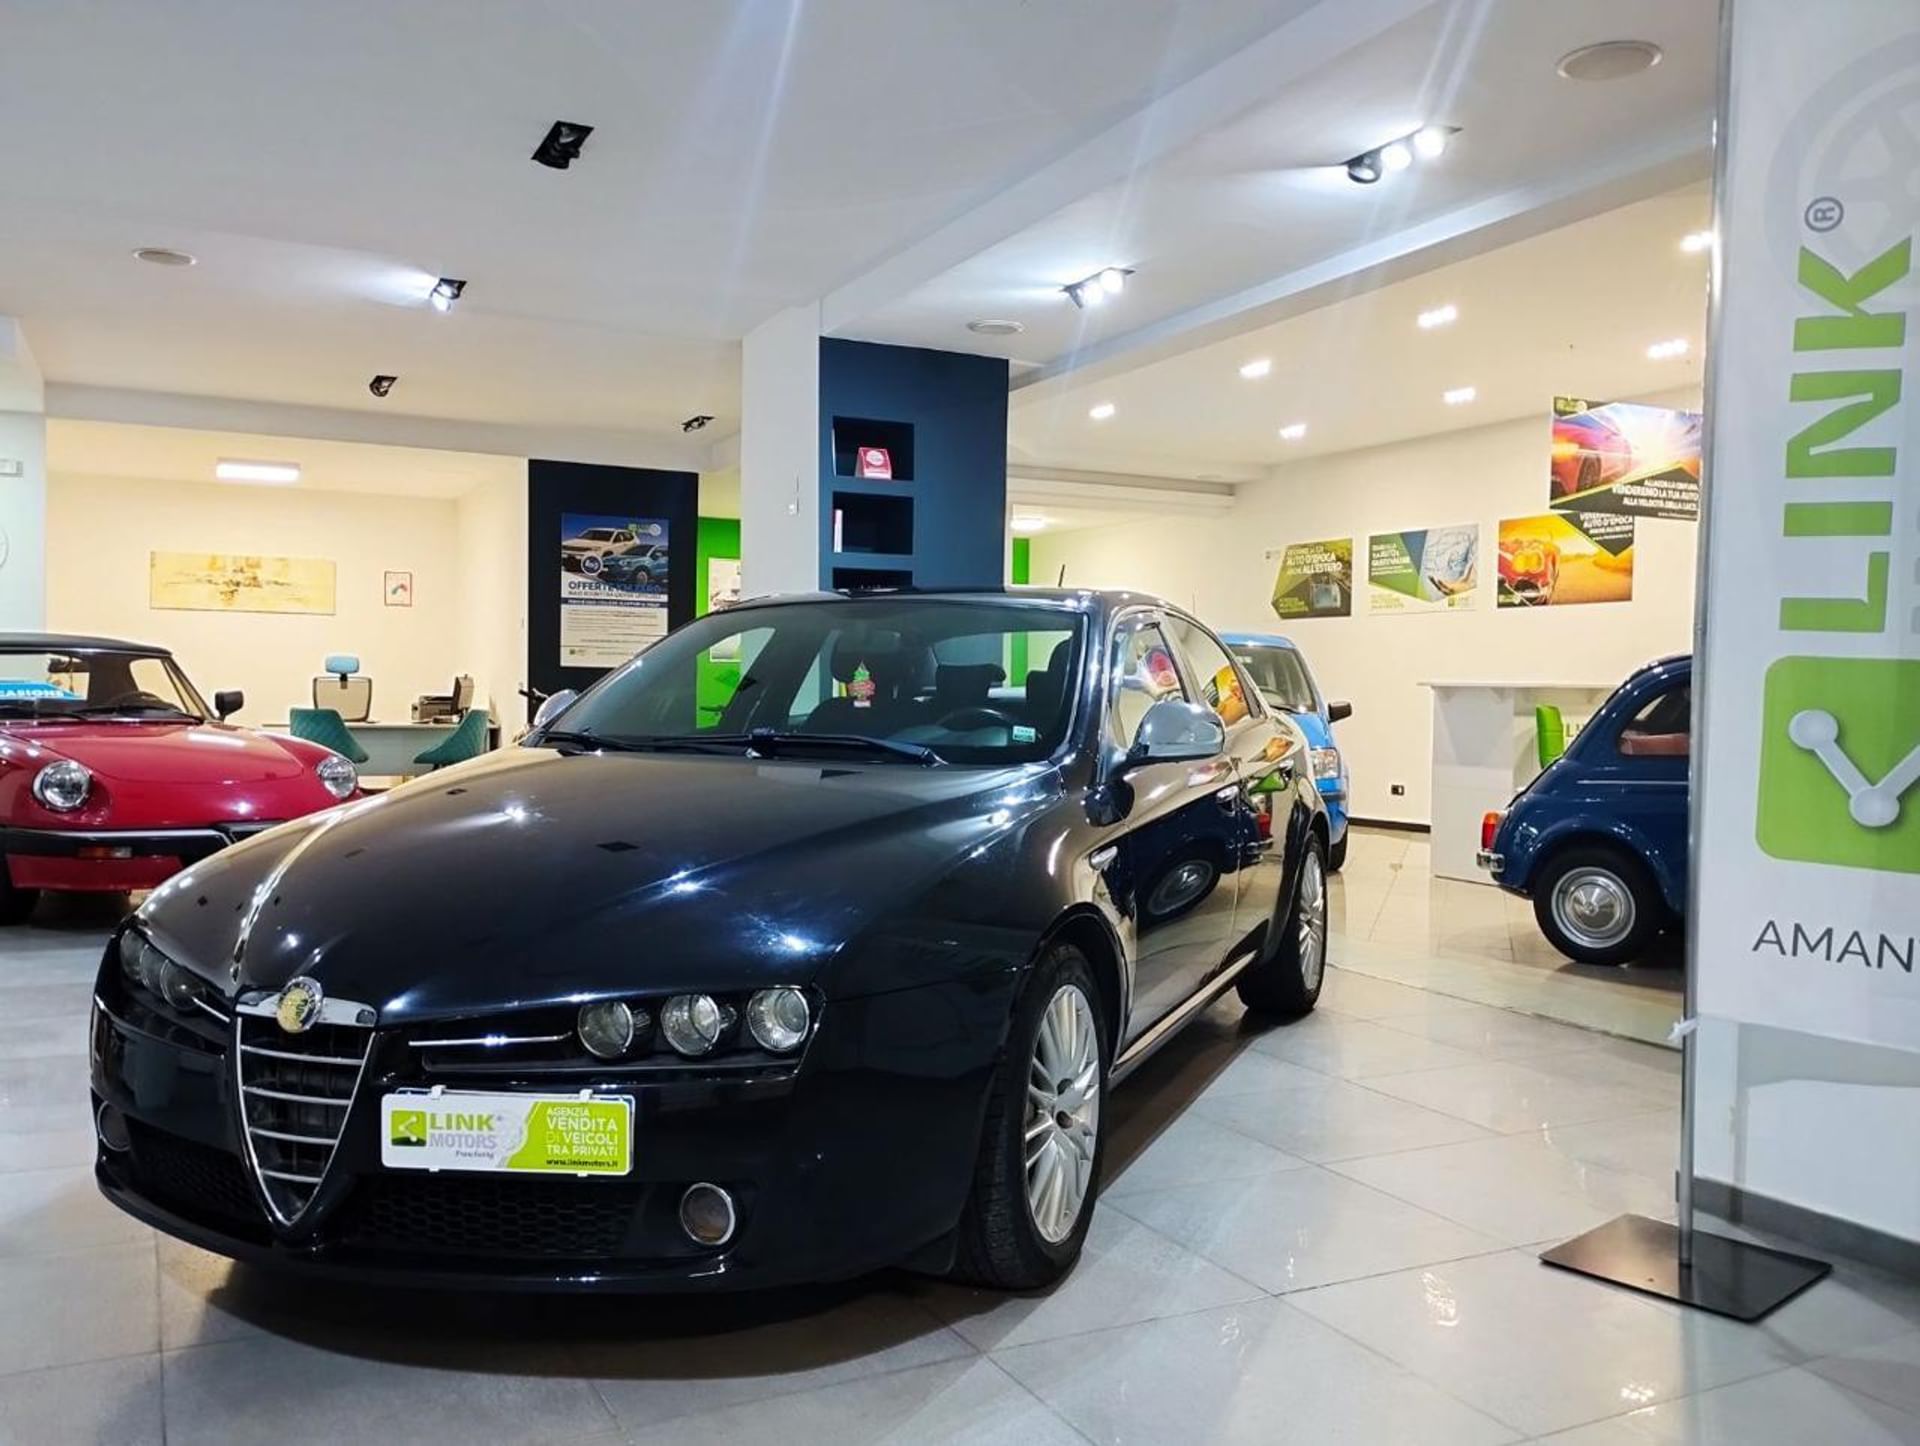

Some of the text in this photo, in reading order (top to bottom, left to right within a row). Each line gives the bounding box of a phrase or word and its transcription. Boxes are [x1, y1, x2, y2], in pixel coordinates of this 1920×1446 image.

[1778, 235, 1911, 634] LINK
[1612, 484, 1699, 501] VENDEREMO LA TUA AUTO
[1623, 496, 1638, 506] ALLA
[1286, 555, 1304, 566] AUTO
[568, 580, 615, 592] OFFERTE
[547, 1107, 590, 1117] AGENZIA
[429, 1112, 495, 1132] LINK
[547, 1116, 618, 1132] VENDITA
[429, 1133, 497, 1149] MOTORS
[547, 1131, 618, 1145] DI VEICOLI
[547, 1145, 618, 1157] TRA PRIVATI
